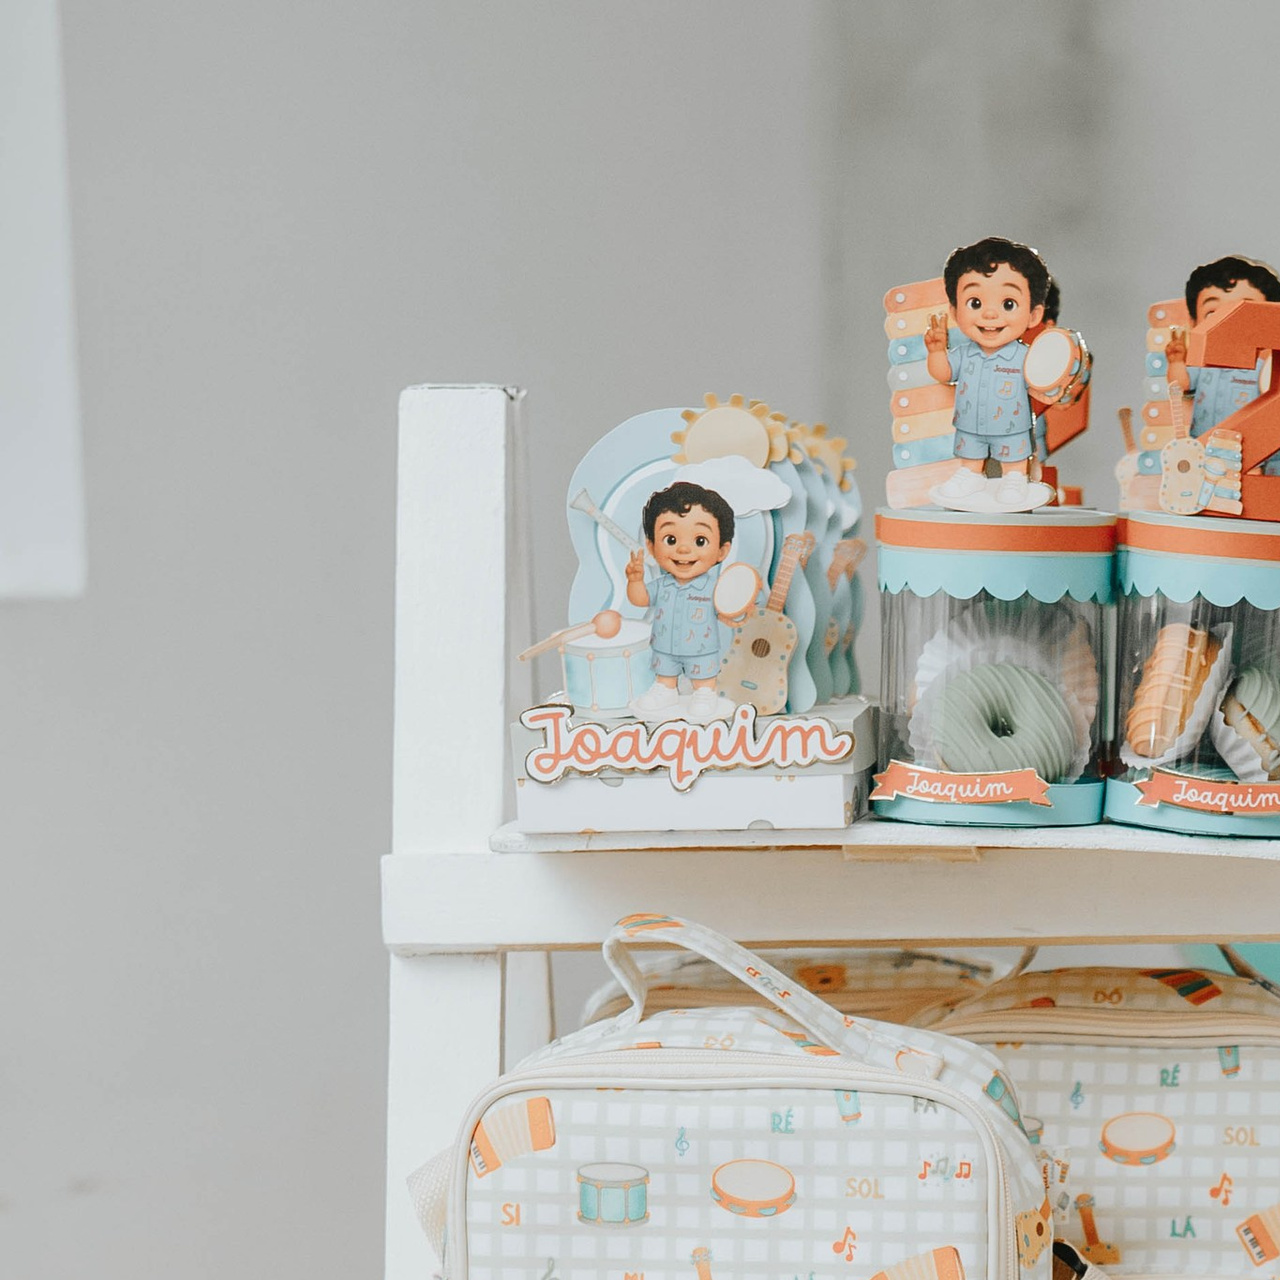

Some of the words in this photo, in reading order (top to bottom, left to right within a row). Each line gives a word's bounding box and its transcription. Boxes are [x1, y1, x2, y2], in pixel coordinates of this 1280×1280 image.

[529, 709, 846, 783] Joaquim
[905, 772, 1013, 801] Joaquim
[1160, 1064, 1182, 1088] RÉ
[771, 1107, 795, 1134] RÉ
[1223, 1126, 1260, 1147] SOL
[846, 1176, 886, 1199] SOL
[501, 1203, 520, 1227] SI
[1170, 1215, 1196, 1237] LÁ
